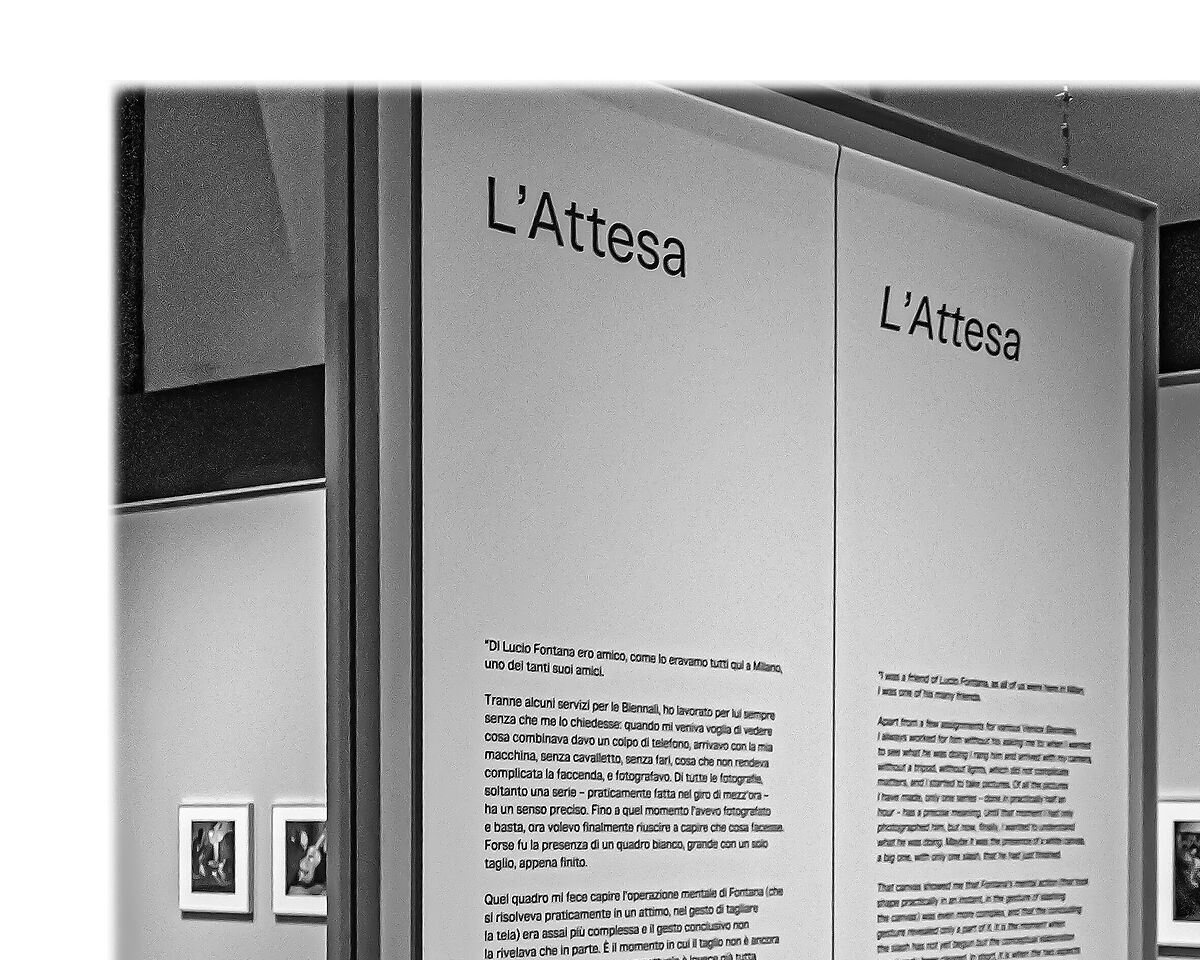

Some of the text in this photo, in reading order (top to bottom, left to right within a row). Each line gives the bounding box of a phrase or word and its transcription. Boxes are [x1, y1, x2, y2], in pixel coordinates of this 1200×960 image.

[487, 176, 686, 278] L'Attesa
[880, 285, 1021, 362] L'Attesa
[502, 640, 531, 654] Lucio
[533, 642, 575, 658] Fontana
[577, 648, 594, 659] ero
[484, 659, 505, 670] uno
[507, 659, 523, 672] dei
[526, 661, 550, 673] tanti
[552, 663, 573, 675] suoi
[484, 693, 522, 707] Tranne
[524, 696, 555, 709] alcuni
[557, 698, 590, 711] servizi
[592, 701, 609, 713] per
[610, 701, 619, 712] le
[484, 713, 516, 725] senza
[518, 713, 538, 726] che
[540, 716, 556, 727] me
[558, 715, 568, 728] lo
[484, 732, 510, 743] cosa
[512, 732, 568, 745] combinava
[570, 733, 595, 746] davo
[597, 736, 610, 746] un
[611, 736, 638, 749] colpo
[540, 752, 570, 762] senza
[484, 767, 543, 780] complicata
[545, 767, 554, 780] la
[484, 784, 651, 799] soltanto una serie praticamente
[484, 802, 497, 814] ha
[500, 805, 513, 814] un
[516, 805, 547, 815] senso
[591, 803, 612, 816] Fino
[484, 823, 491, 833] e
[527, 823, 545, 833] ora
[547, 820, 580, 833] volevo
[582, 821, 634, 833] finalmente
[484, 838, 514, 851] Forse
[517, 838, 527, 850] fu
[530, 838, 539, 850] la
[541, 840, 588, 852] presenza
[590, 838, 599, 850] di
[601, 840, 614, 850] un
[518, 858, 557, 871] appena
[483, 892, 509, 906] Quel
[511, 892, 548, 906] quadro
[551, 891, 563, 903] mi
[566, 890, 588, 903] fece
[589, 890, 620, 904] capire
[484, 911, 493, 924] si
[495, 910, 542, 923] risolveva
[544, 908, 611, 923] praticamente
[613, 907, 622, 918] in
[484, 929, 493, 942] la
[522, 929, 539, 940] era
[541, 926, 567, 939] assai
[569, 925, 585, 940] più
[587, 924, 639, 938] complessa
[484, 948, 493, 960] la
[496, 946, 537, 959] rivelava
[539, 945, 558, 957] che
[560, 943, 569, 955] in
[611, 941, 617, 952] il
